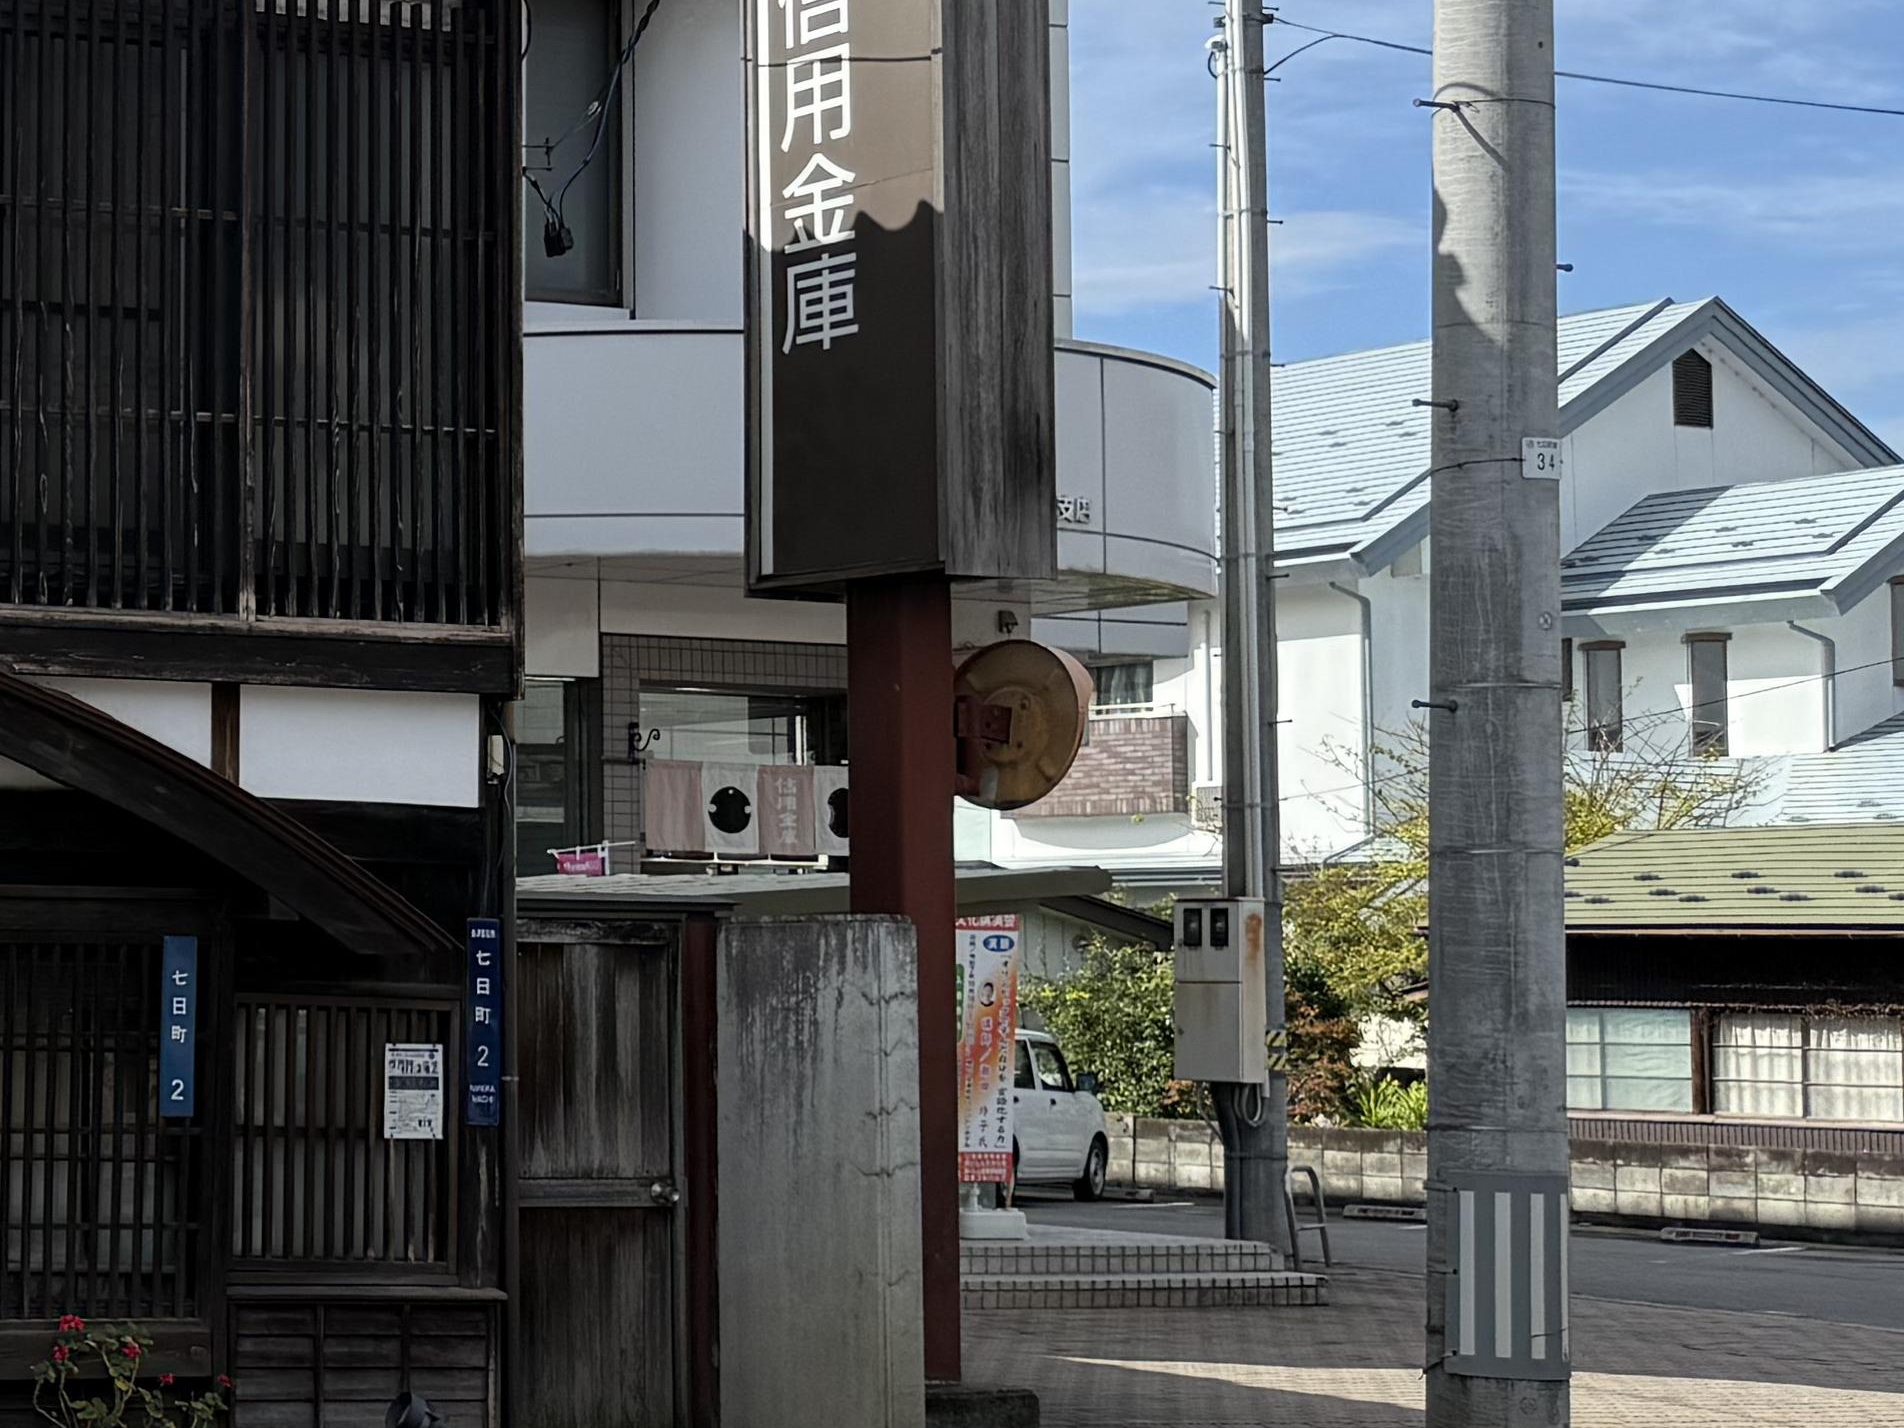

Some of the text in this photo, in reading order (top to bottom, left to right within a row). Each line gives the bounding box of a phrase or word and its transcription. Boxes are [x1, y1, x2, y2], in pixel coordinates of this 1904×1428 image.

[1537, 452, 1555, 471] 34
[773, 777, 798, 844] 信用金庫
[474, 949, 493, 1025] 七日町
[169, 969, 190, 1101] 七日町 2
[476, 1044, 490, 1068] 2
